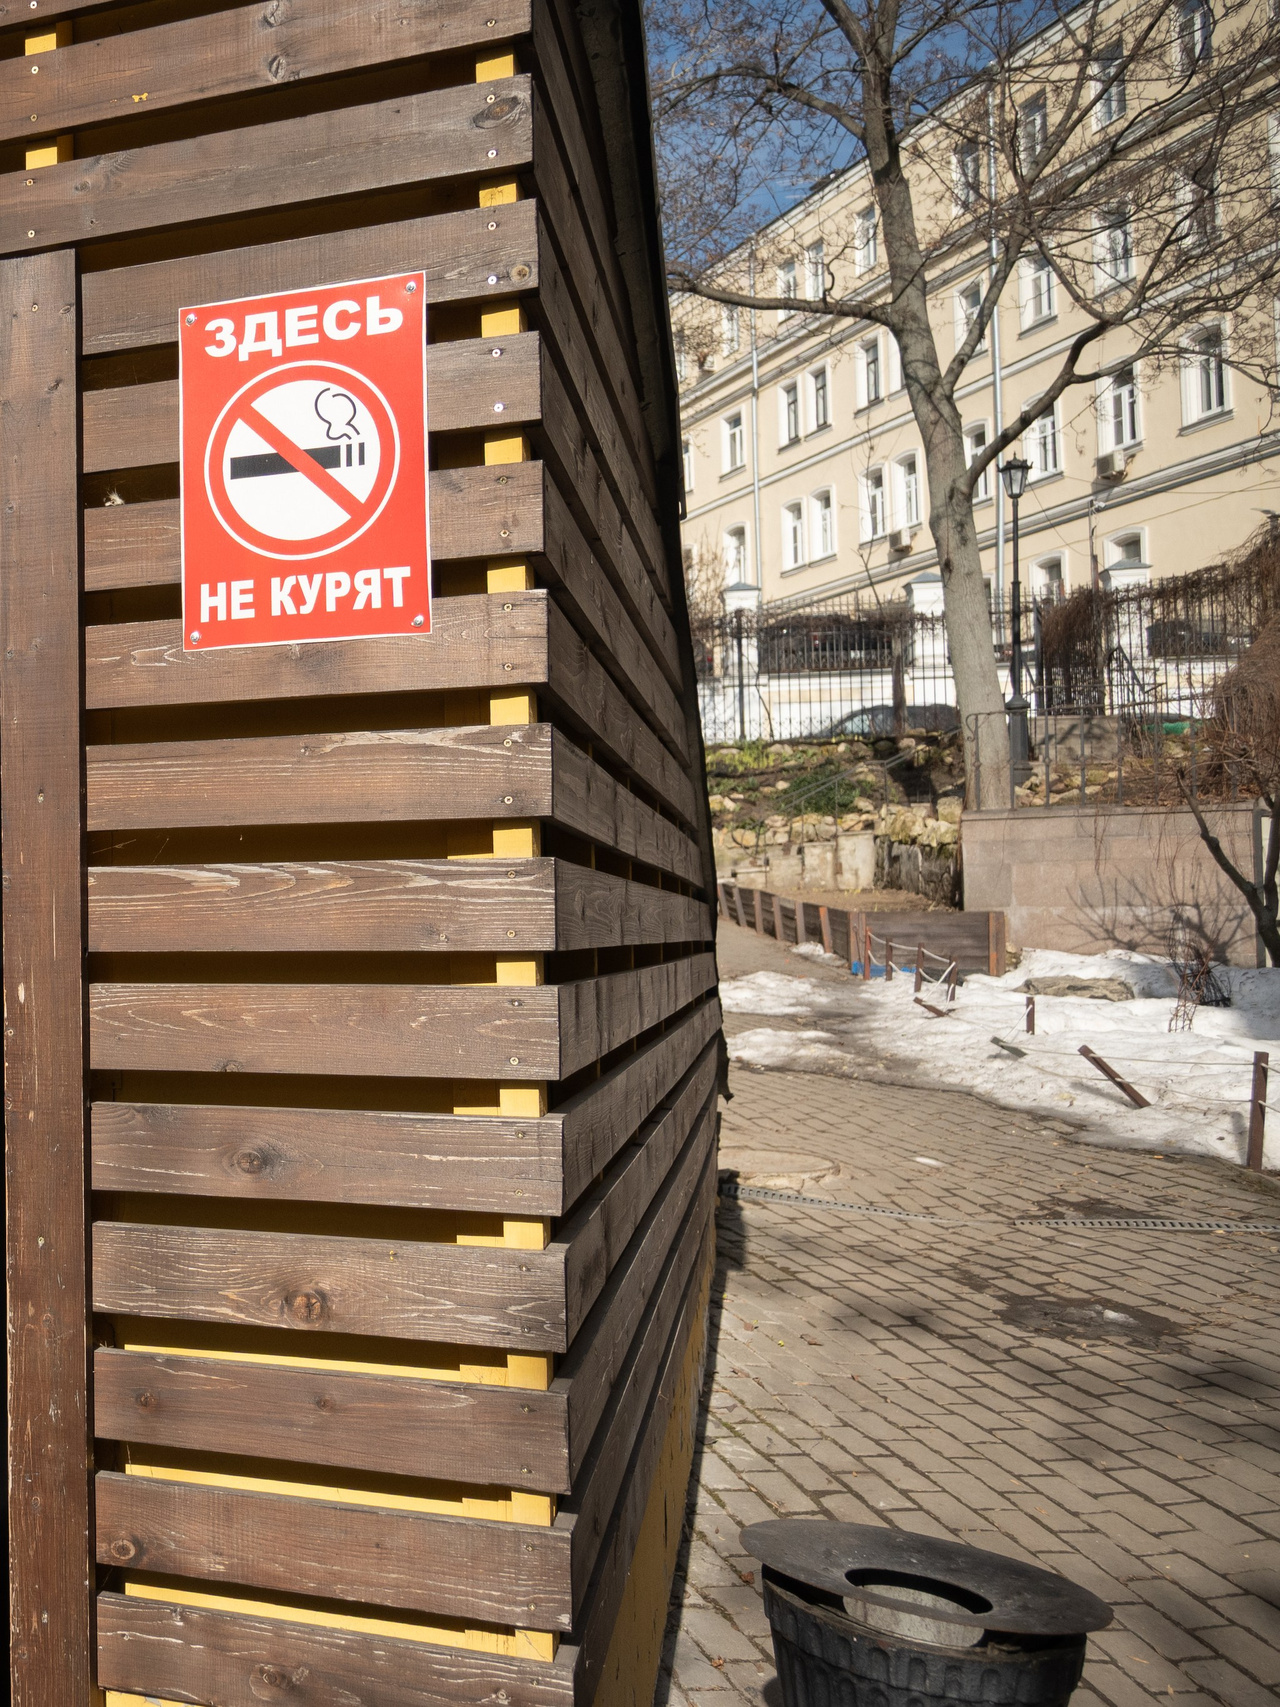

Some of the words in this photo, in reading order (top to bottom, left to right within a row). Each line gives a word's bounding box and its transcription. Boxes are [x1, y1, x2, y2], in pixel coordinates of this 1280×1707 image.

[204, 296, 403, 362] ЗДЕСЬ
[200, 580, 255, 623] НЕ
[271, 566, 411, 617] КУРЯТ
